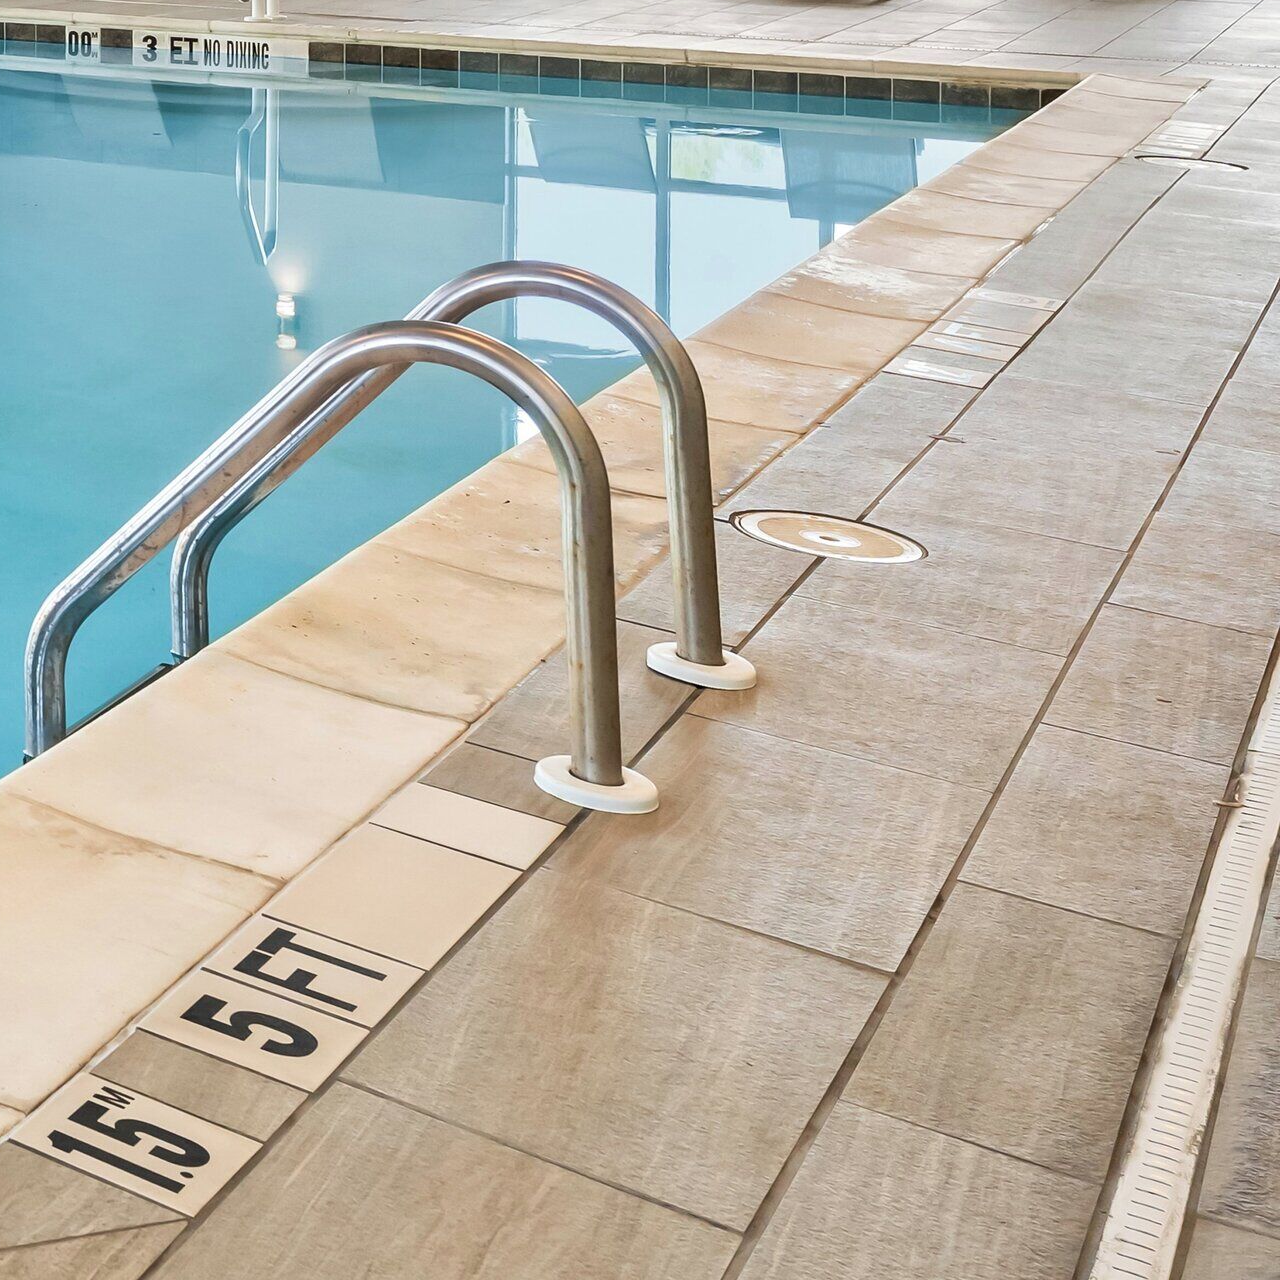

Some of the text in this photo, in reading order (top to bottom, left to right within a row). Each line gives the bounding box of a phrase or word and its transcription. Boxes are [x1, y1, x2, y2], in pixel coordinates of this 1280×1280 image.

[142, 35, 158, 56] 3
[204, 39, 220, 61] NO
[227, 41, 270, 65] DIVING
[232, 926, 388, 1013] FT
[179, 993, 319, 1058] 5
